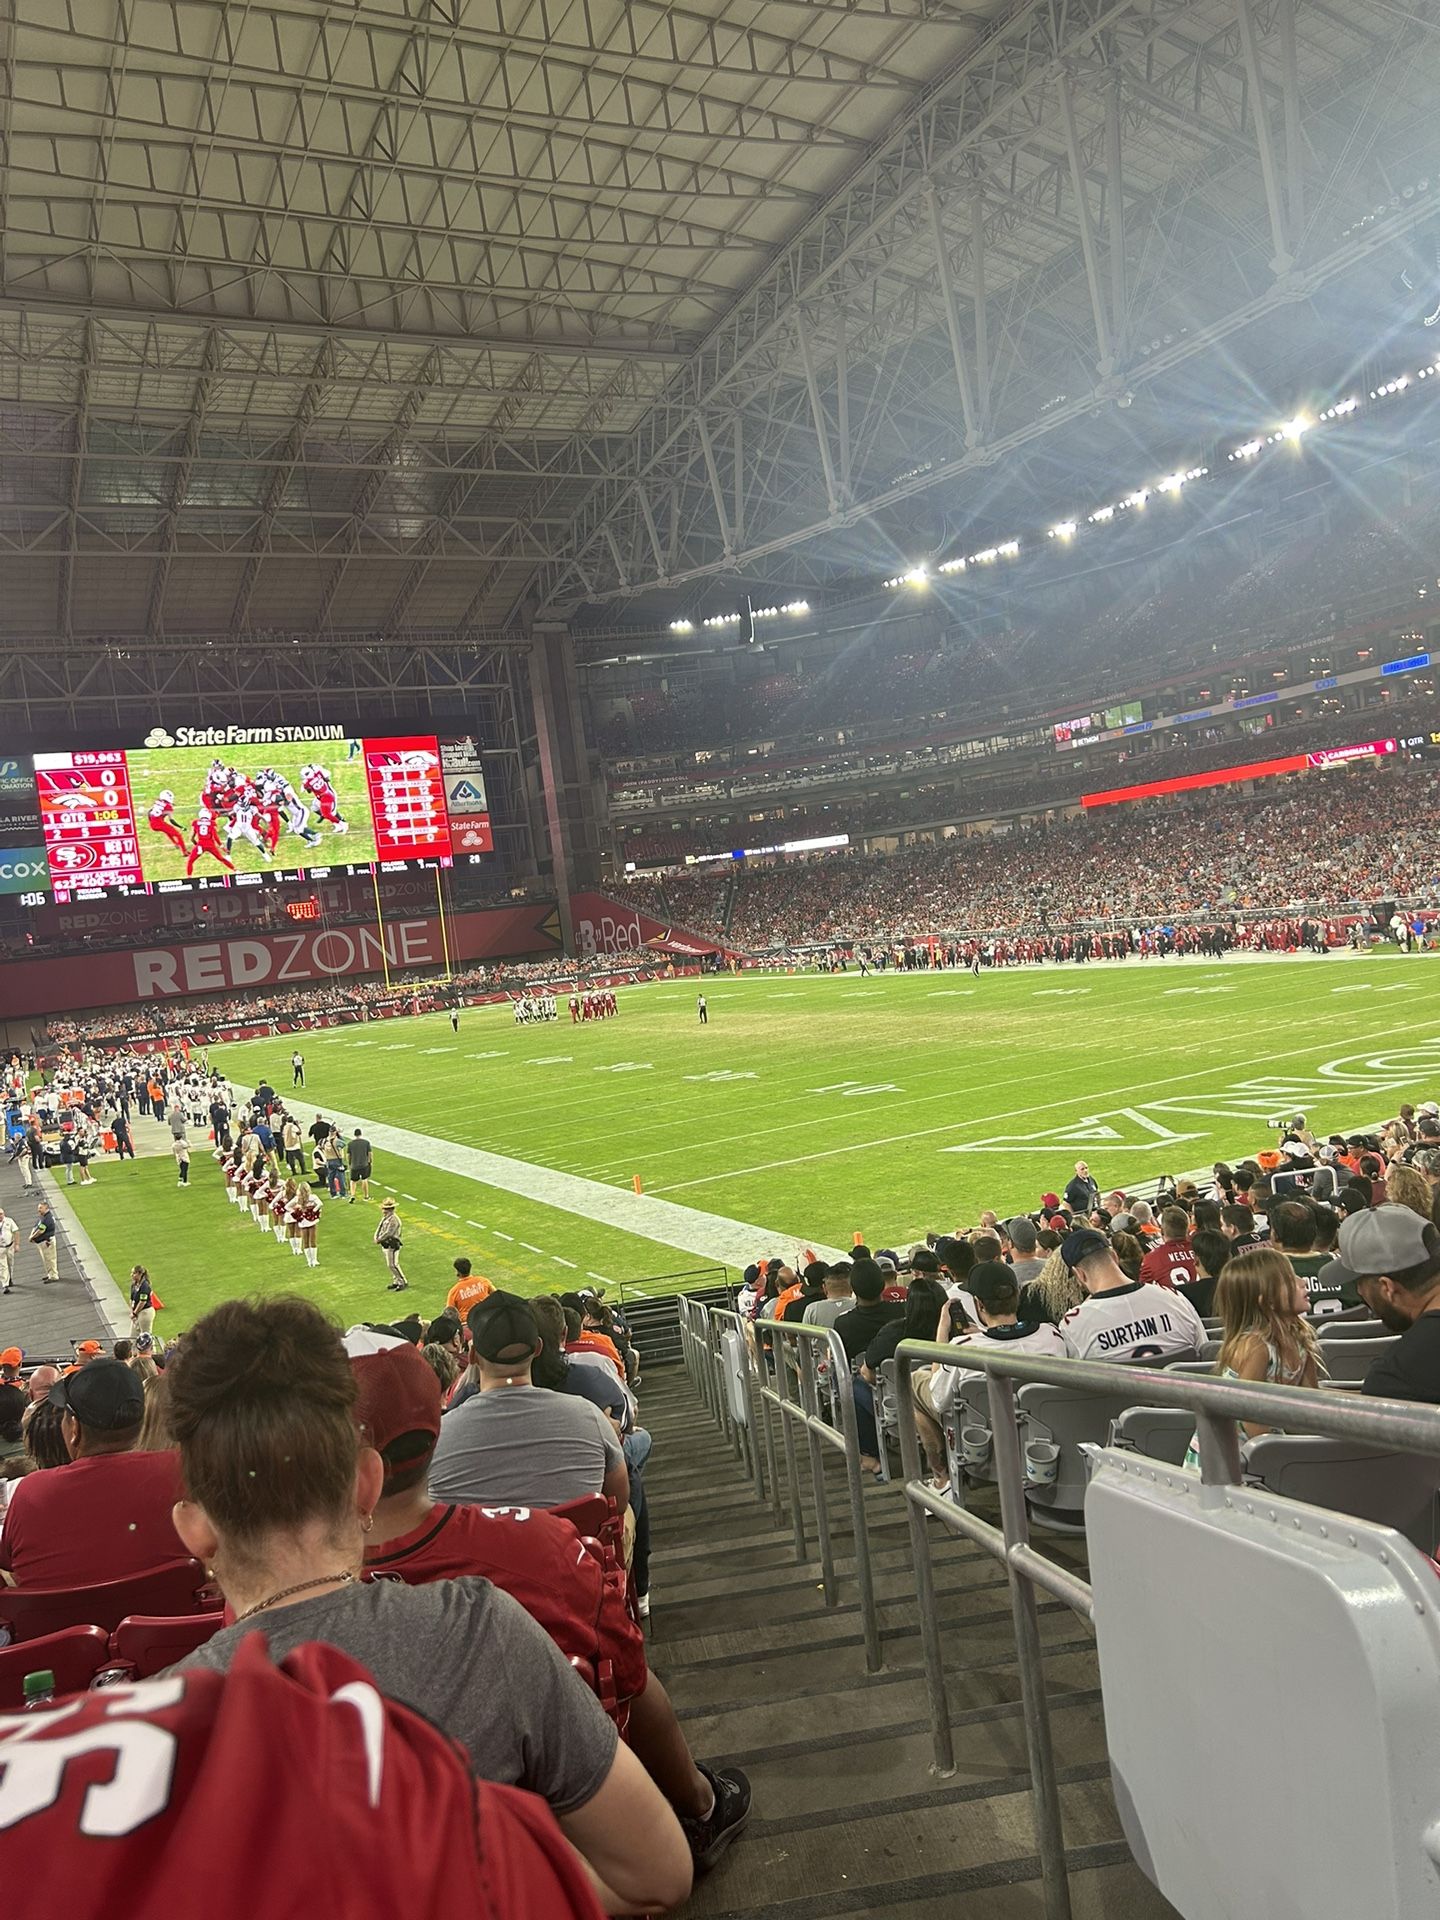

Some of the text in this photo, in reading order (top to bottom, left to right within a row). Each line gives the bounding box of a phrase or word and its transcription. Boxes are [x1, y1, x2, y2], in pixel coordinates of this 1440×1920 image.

[1315, 678, 1337, 691] COX
[274, 724, 345, 742] STADIUM
[1408, 736, 1424, 746] QTR
[74, 752, 122, 766] $19,963
[1328, 745, 1375, 760] CARDINALS
[101, 770, 116, 786] 0
[103, 790, 118, 806] 0
[12, 813, 37, 822] RIVER
[48, 814, 55, 824] 1
[60, 812, 87, 824] QTR
[93, 809, 119, 821] 1:06
[0, 861, 46, 879] COX
[20, 891, 46, 906] 1:06
[170, 895, 243, 923] BUD
[59, 908, 148, 931] REDZONE
[133, 920, 433, 997] REDZONE
[612, 966, 640, 974] CARDINALS
[525, 979, 548, 987] ARIZONA
[213, 1021, 243, 1030] ARIZONA
[126, 1033, 157, 1042] ARIZONA
[805, 1081, 897, 1095] 10
[1098, 1316, 1158, 1351] SURTAIN
